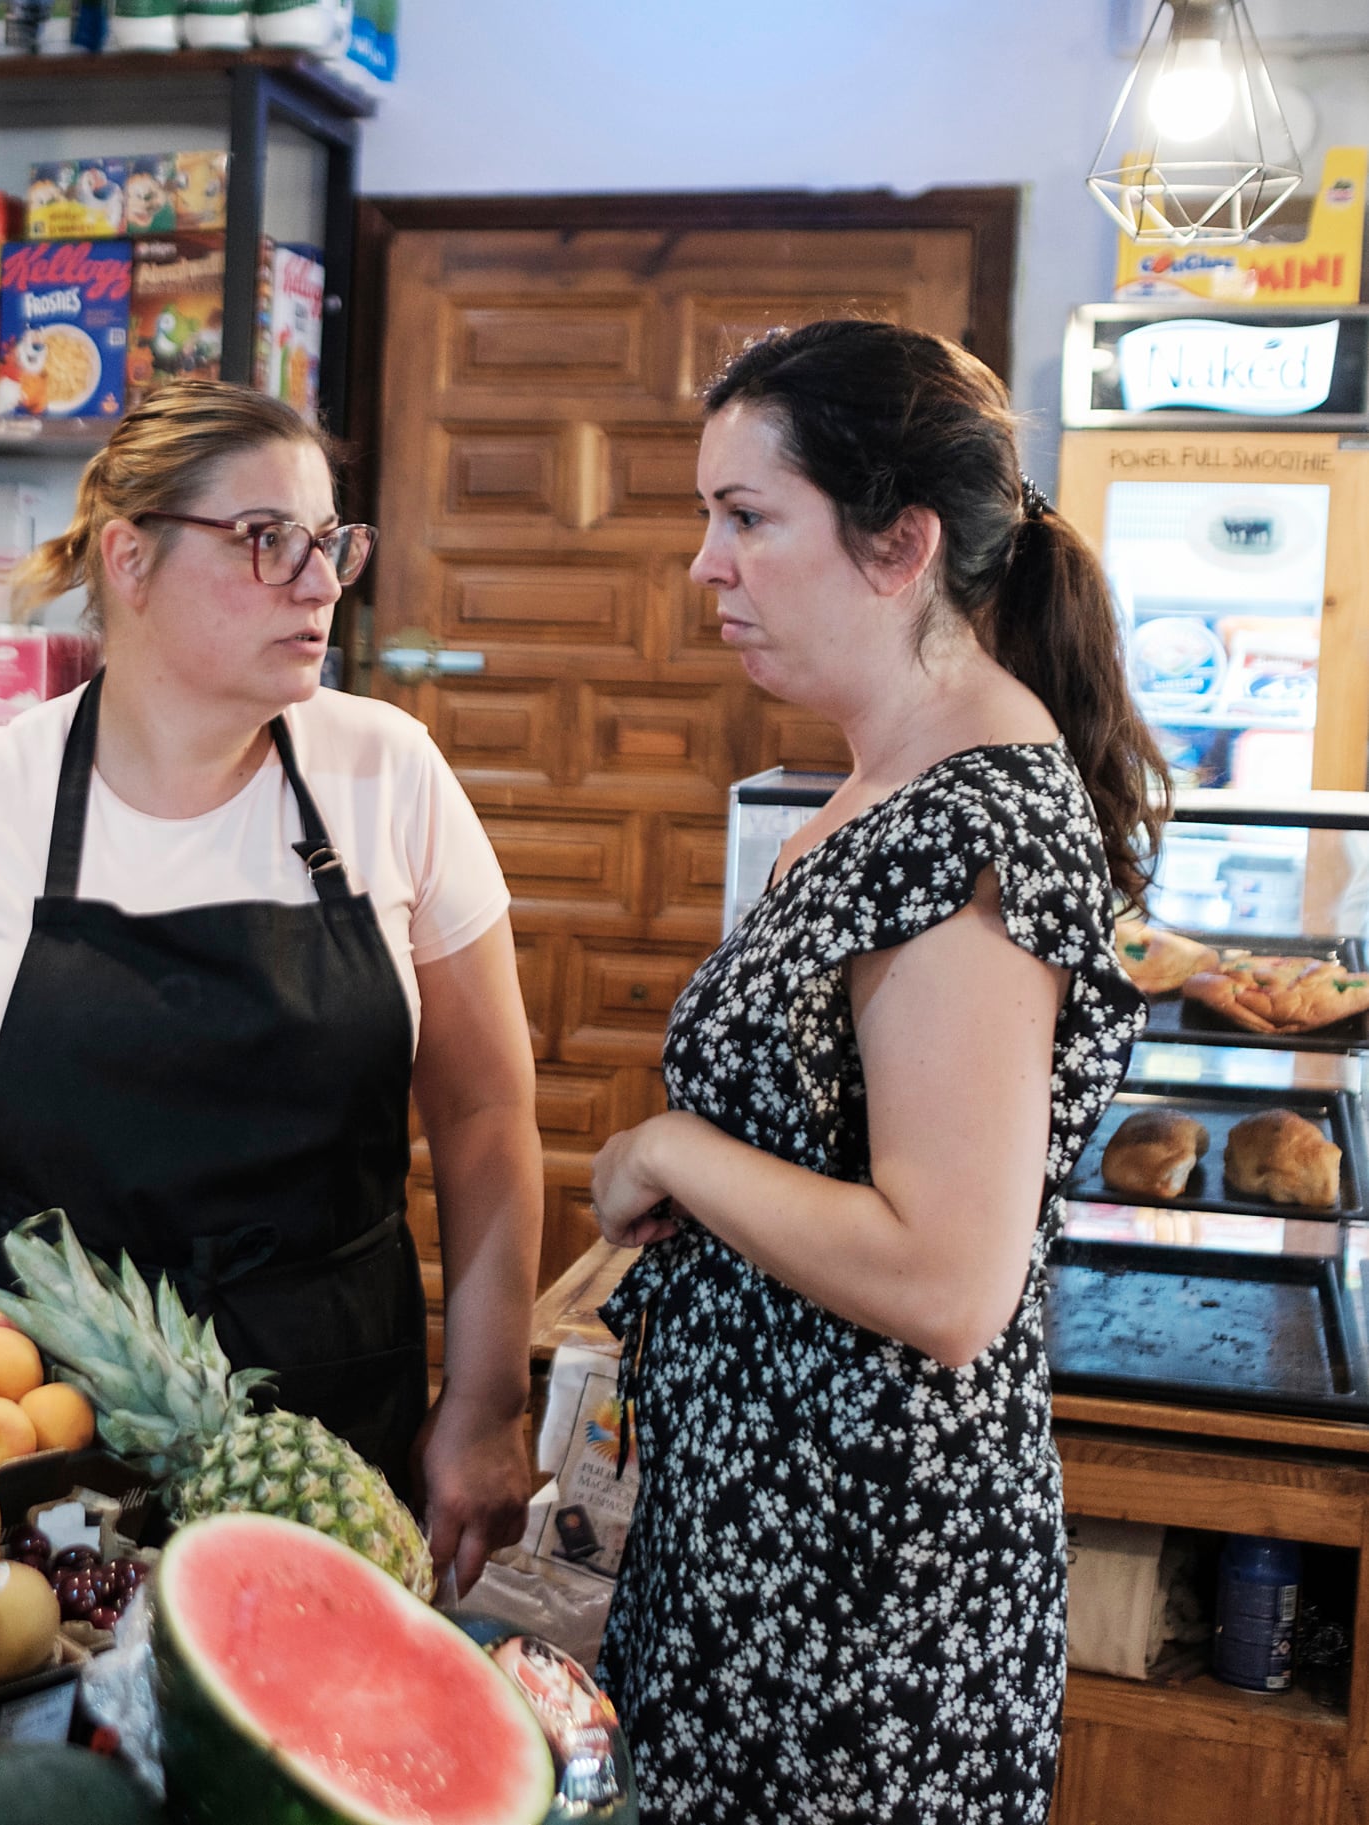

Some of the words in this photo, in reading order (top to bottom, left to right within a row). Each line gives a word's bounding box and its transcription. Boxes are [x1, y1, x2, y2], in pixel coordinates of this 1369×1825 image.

[1248, 255, 1344, 290] MINI
[23, 288, 81, 318] FROSTIES
[1148, 340, 1309, 389] Naked
[1110, 448, 1175, 468] POWER
[1182, 447, 1227, 467] FULL
[1233, 448, 1334, 472] SMOOTHIE
